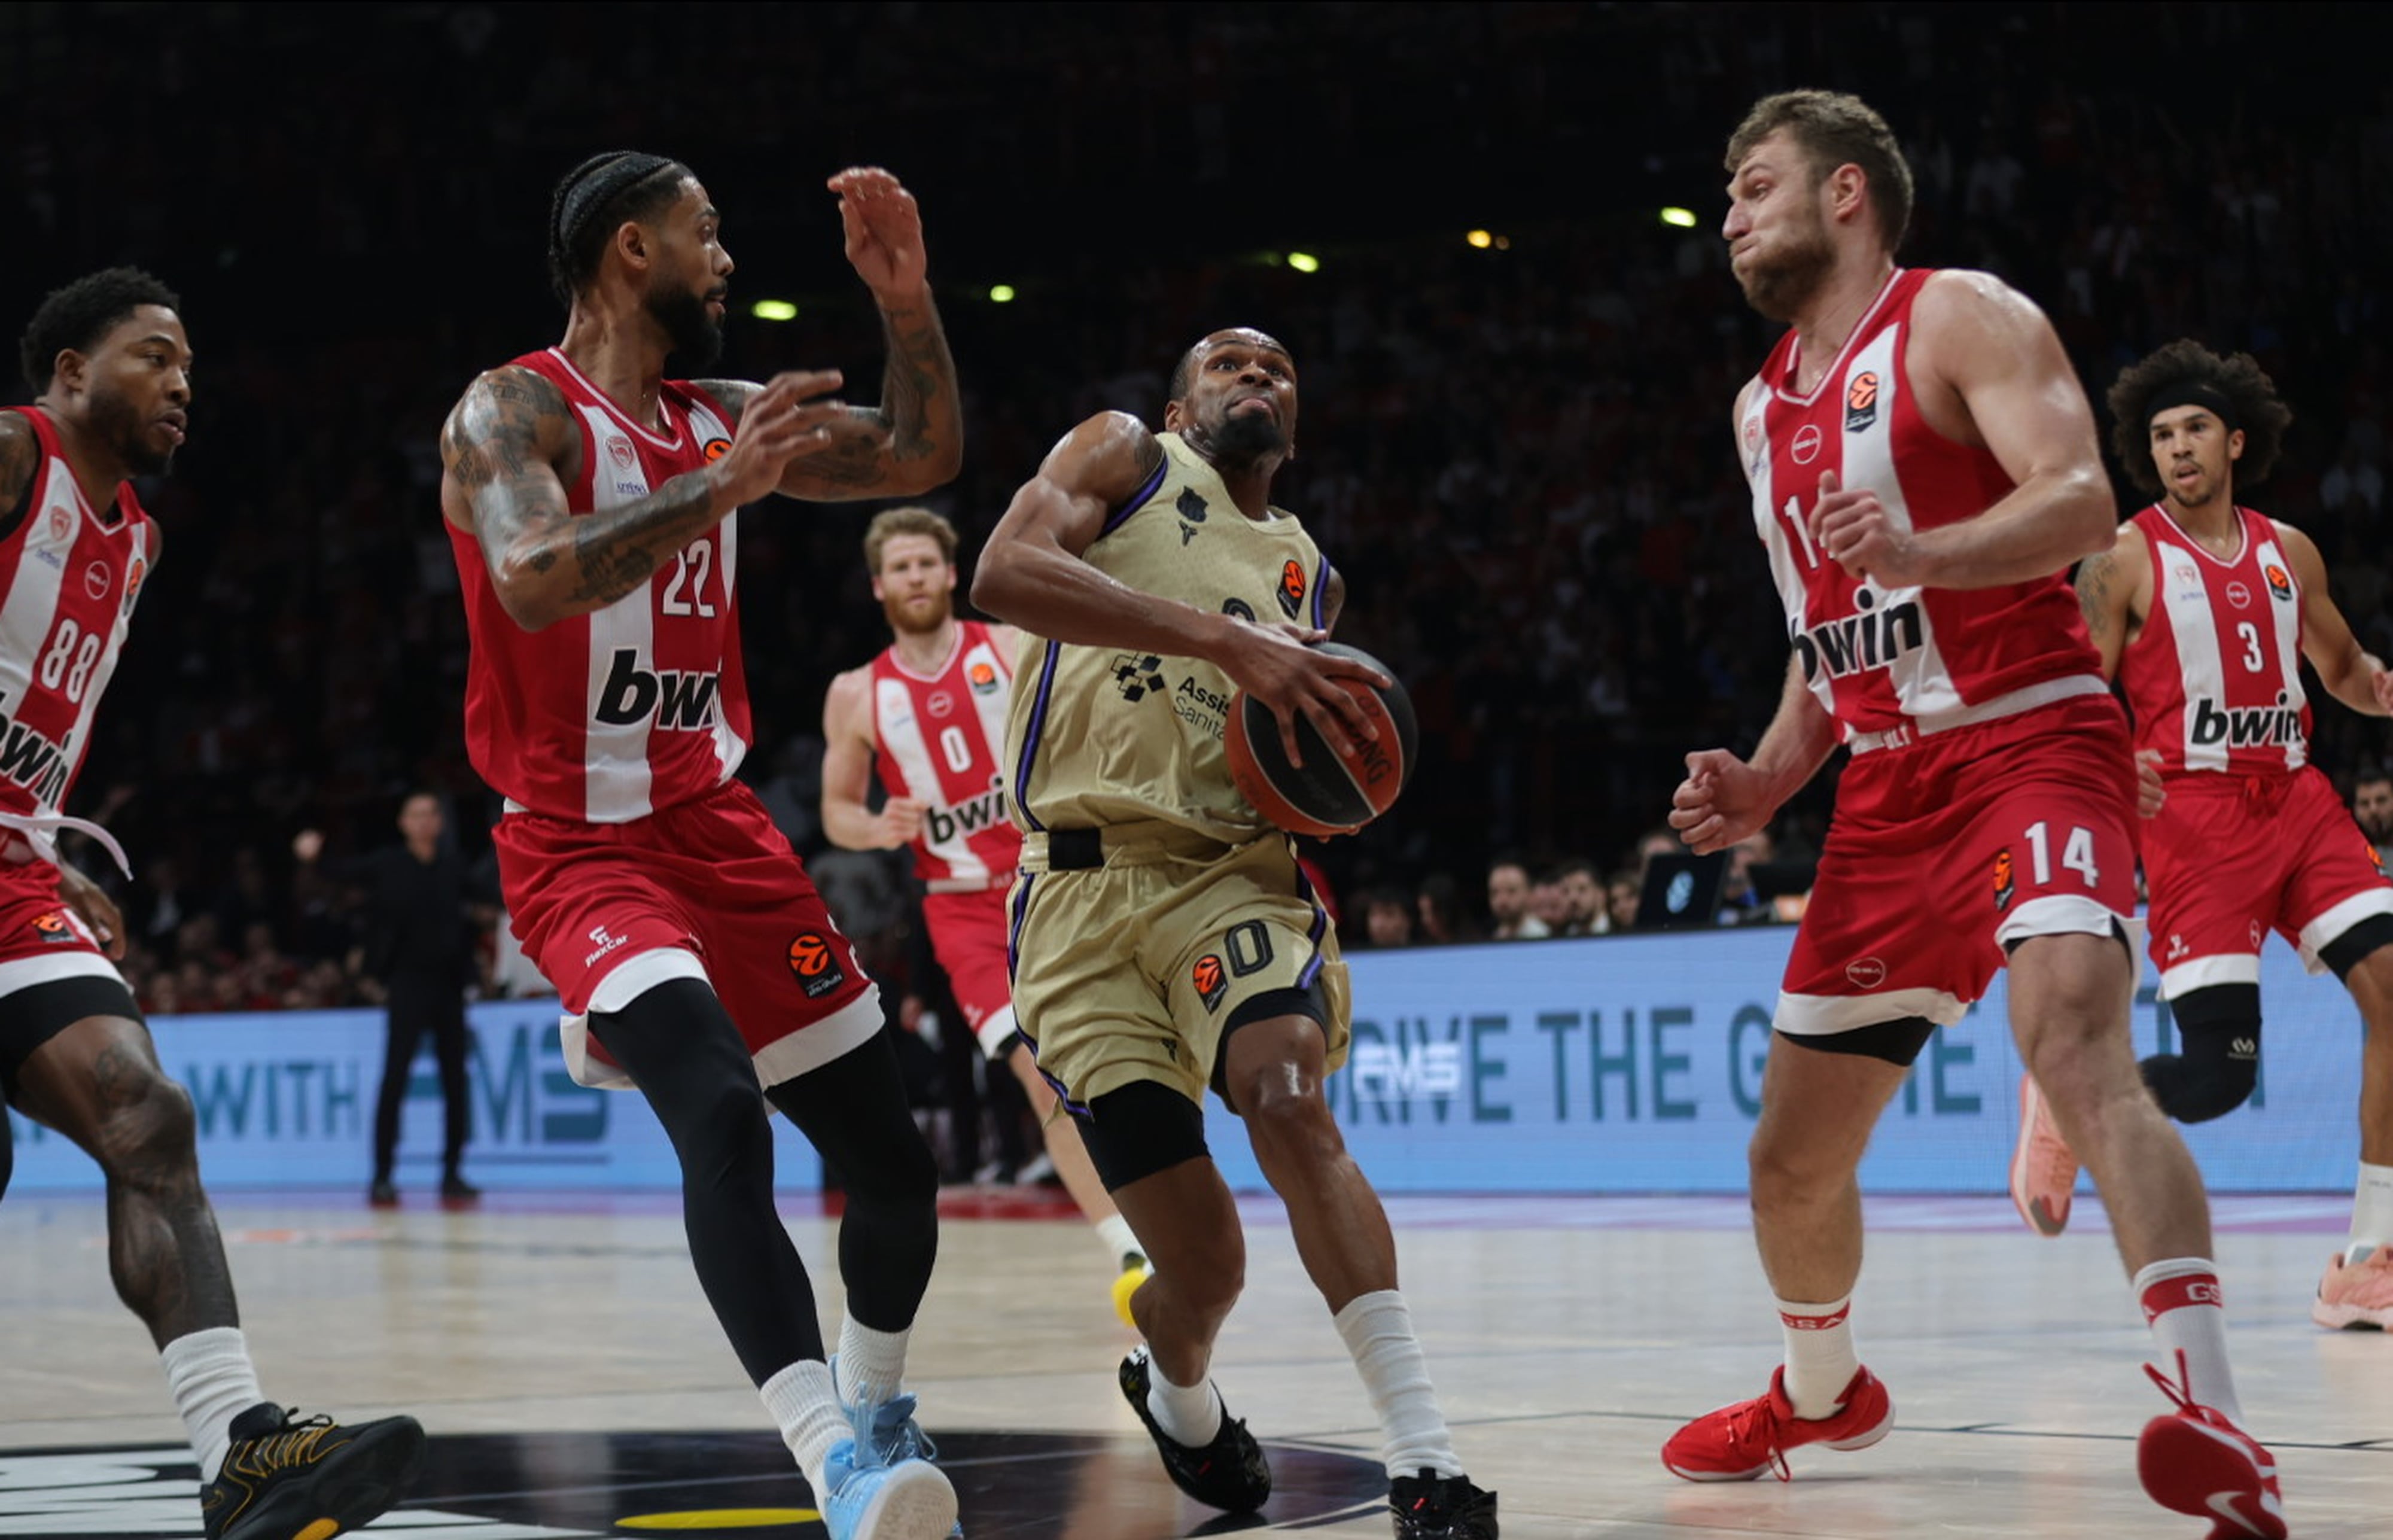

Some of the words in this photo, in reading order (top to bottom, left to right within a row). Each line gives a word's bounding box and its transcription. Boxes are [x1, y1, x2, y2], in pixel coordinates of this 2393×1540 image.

[1784, 495, 1835, 568] 1
[662, 539, 715, 617] 22
[42, 619, 100, 704] 88
[2237, 622, 2264, 672] 3
[596, 649, 721, 728] bw
[2191, 692, 2302, 745] bwin
[940, 726, 972, 773] 0
[2024, 821, 2100, 888] 14
[1224, 919, 1274, 978] 0
[183, 1061, 360, 1139] WITH
[1325, 1016, 1512, 1125] RIVE
[1538, 1008, 1697, 1122] THE
